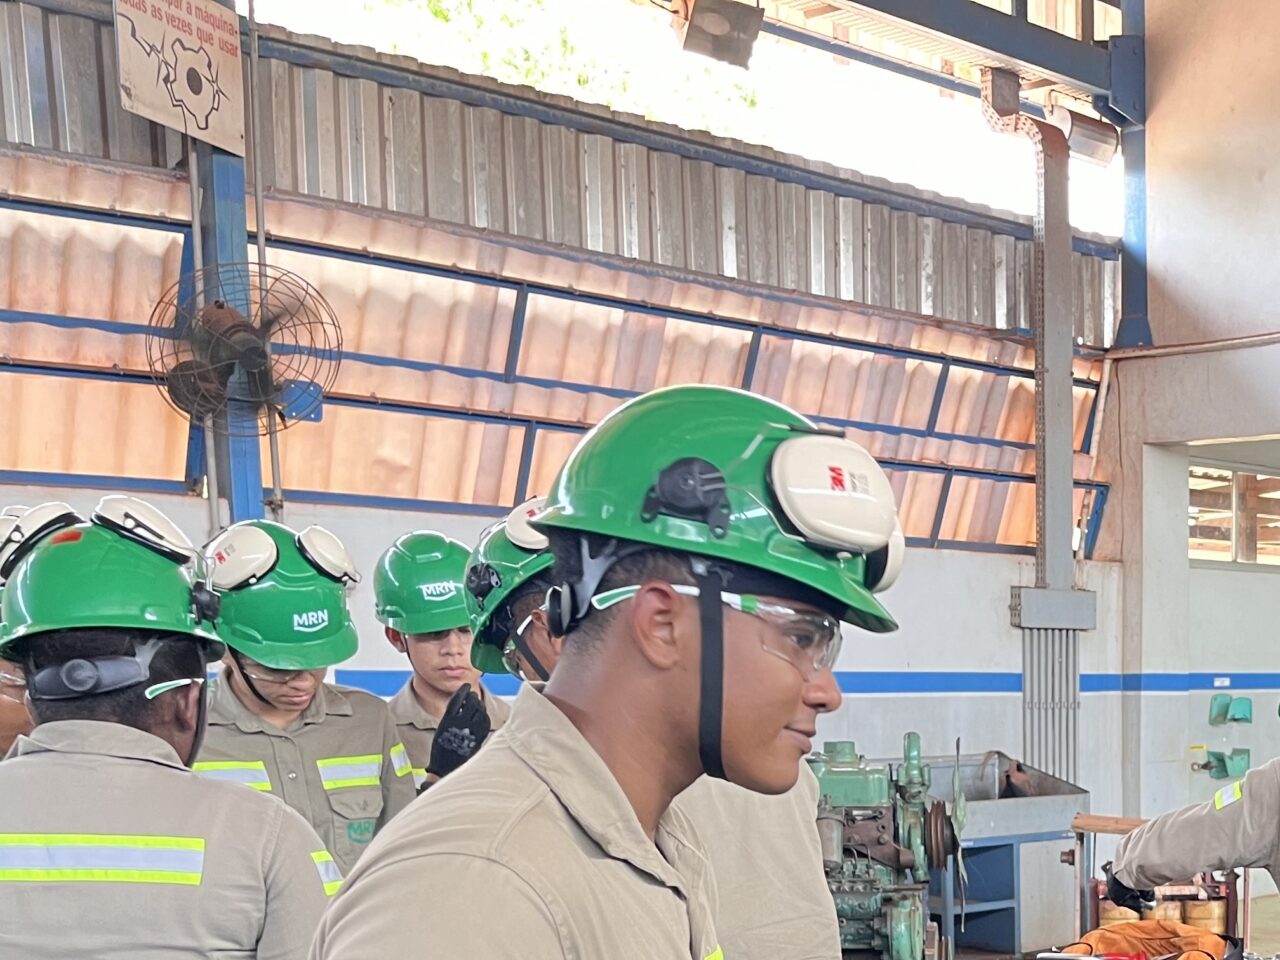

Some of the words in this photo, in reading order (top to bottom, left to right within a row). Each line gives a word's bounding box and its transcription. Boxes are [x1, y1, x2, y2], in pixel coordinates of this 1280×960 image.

[186, 1, 193, 15] a
[150, 4, 163, 21] as
[164, 11, 193, 36] vezes
[196, 26, 214, 46] que
[218, 37, 238, 57] usar
[421, 580, 456, 597] MRN
[293, 609, 329, 627] MRN
